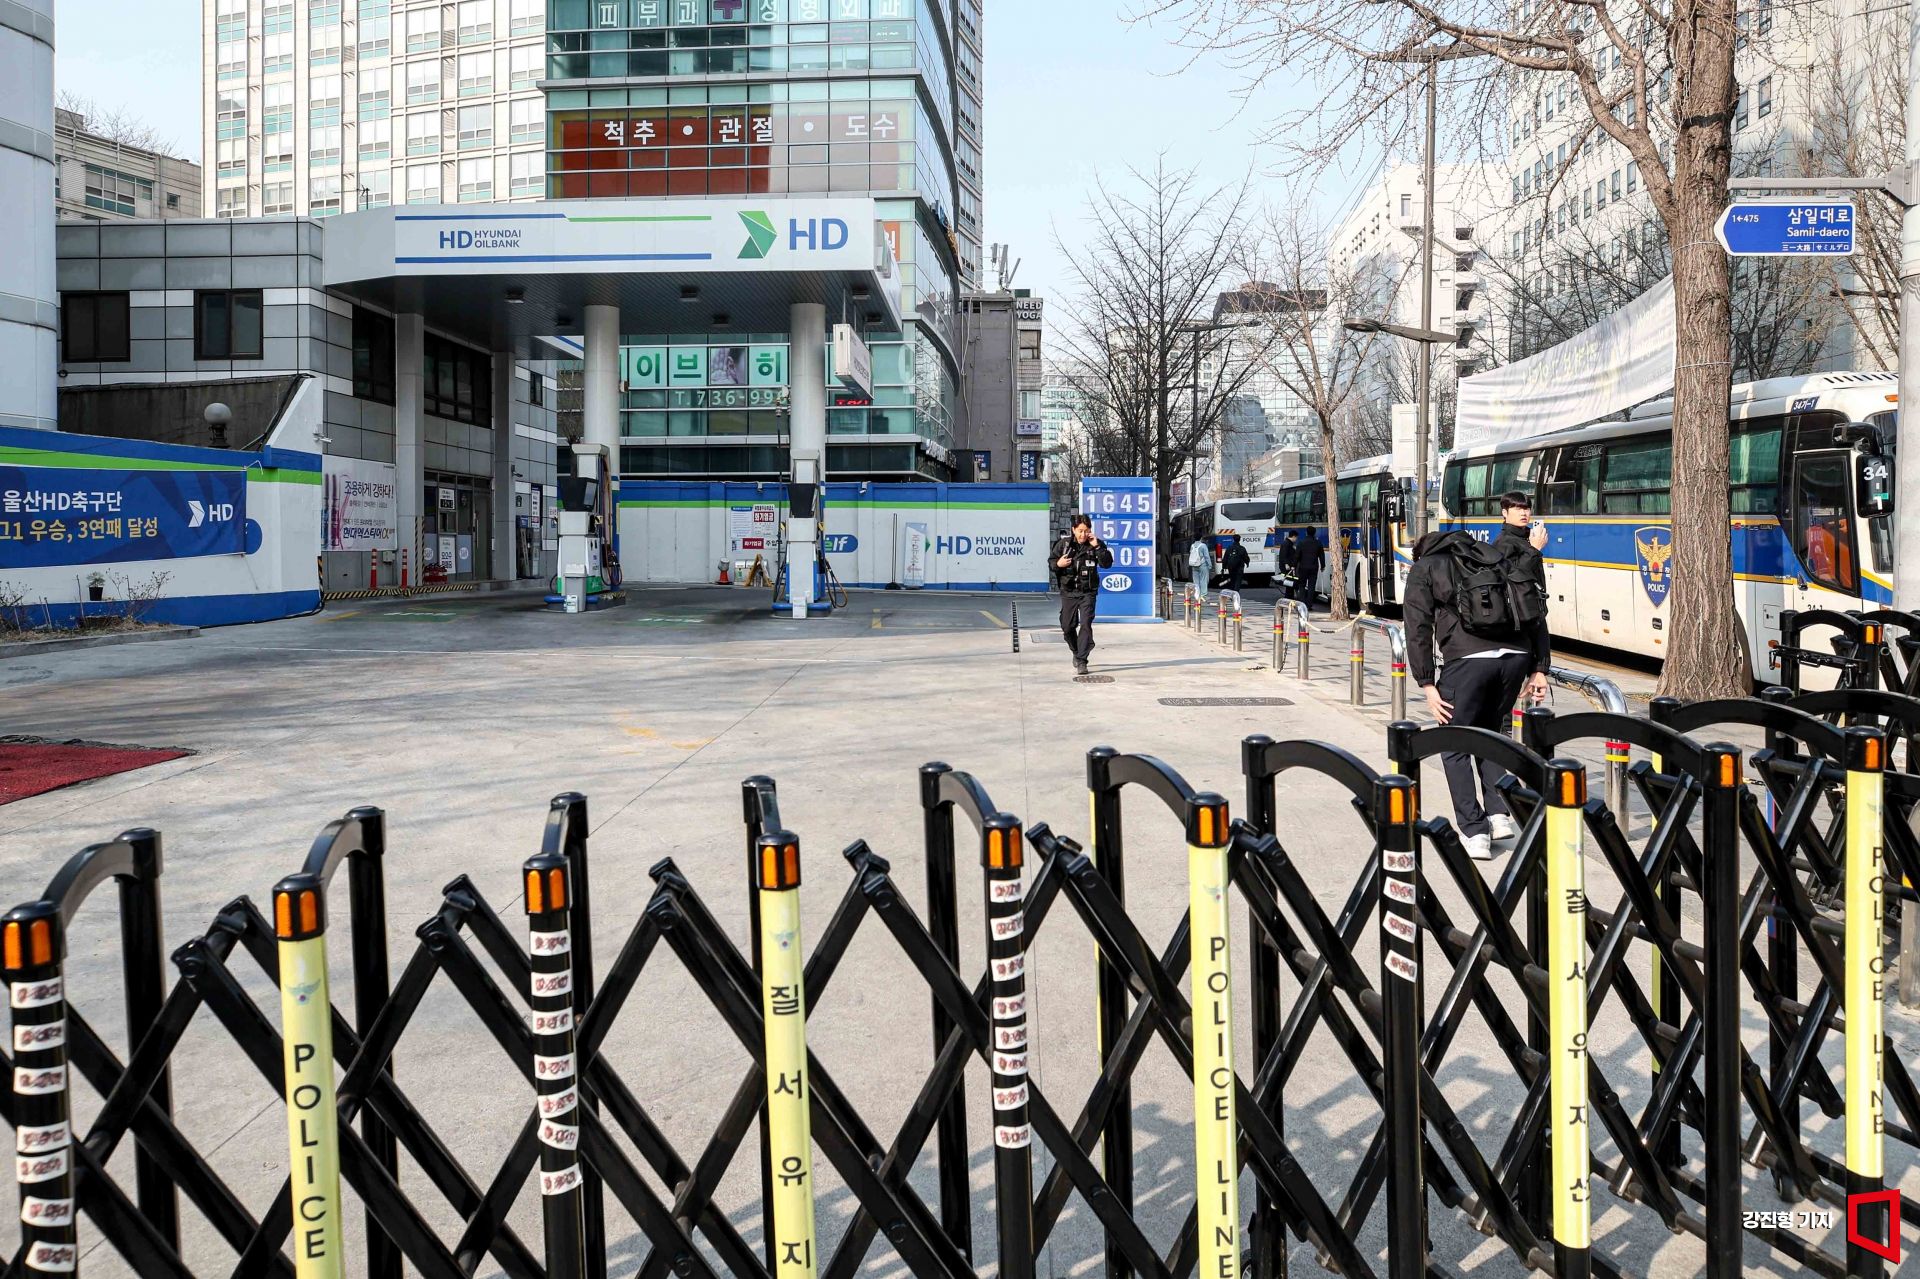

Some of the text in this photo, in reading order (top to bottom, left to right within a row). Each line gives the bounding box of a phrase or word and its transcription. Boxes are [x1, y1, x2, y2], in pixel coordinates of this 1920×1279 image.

[600, 1, 698, 27] 피부과
[604, 114, 896, 146] 척추 관절 도수
[1787, 208, 1850, 225] 삼일대로
[439, 230, 522, 249] HD HYUNDAI
[789, 218, 849, 250] HD
[1787, 227, 1850, 237] Samil-daero
[474, 239, 520, 249] OILBANK
[1782, 244, 1811, 252] 三一大路
[1016, 302, 1042, 310] NEED
[1016, 311, 1042, 320] YOGA
[619, 352, 702, 384] 이브
[1863, 465, 1888, 480] 34
[344, 480, 394, 499] 조용하게 강하다!
[3, 490, 123, 513] 울산HD축구단
[1086, 494, 1150, 513] 1645
[208, 503, 234, 522] HD
[29, 519, 73, 543] 우승,
[77, 518, 122, 539] 3연패
[128, 517, 158, 538] 달성
[1465, 530, 1490, 544] OLICE
[824, 537, 848, 551] elf
[936, 536, 1026, 555] HD HYUNDAI
[975, 547, 1024, 556] OILBANK
[1105, 576, 1129, 589] Self
[1647, 583, 1666, 593] POLICE
[1868, 846, 1885, 1135] POLICE LINE
[1207, 936, 1234, 1279] POLICE LINE
[770, 983, 811, 1270] 질서유지
[293, 1043, 327, 1259] POLICE
